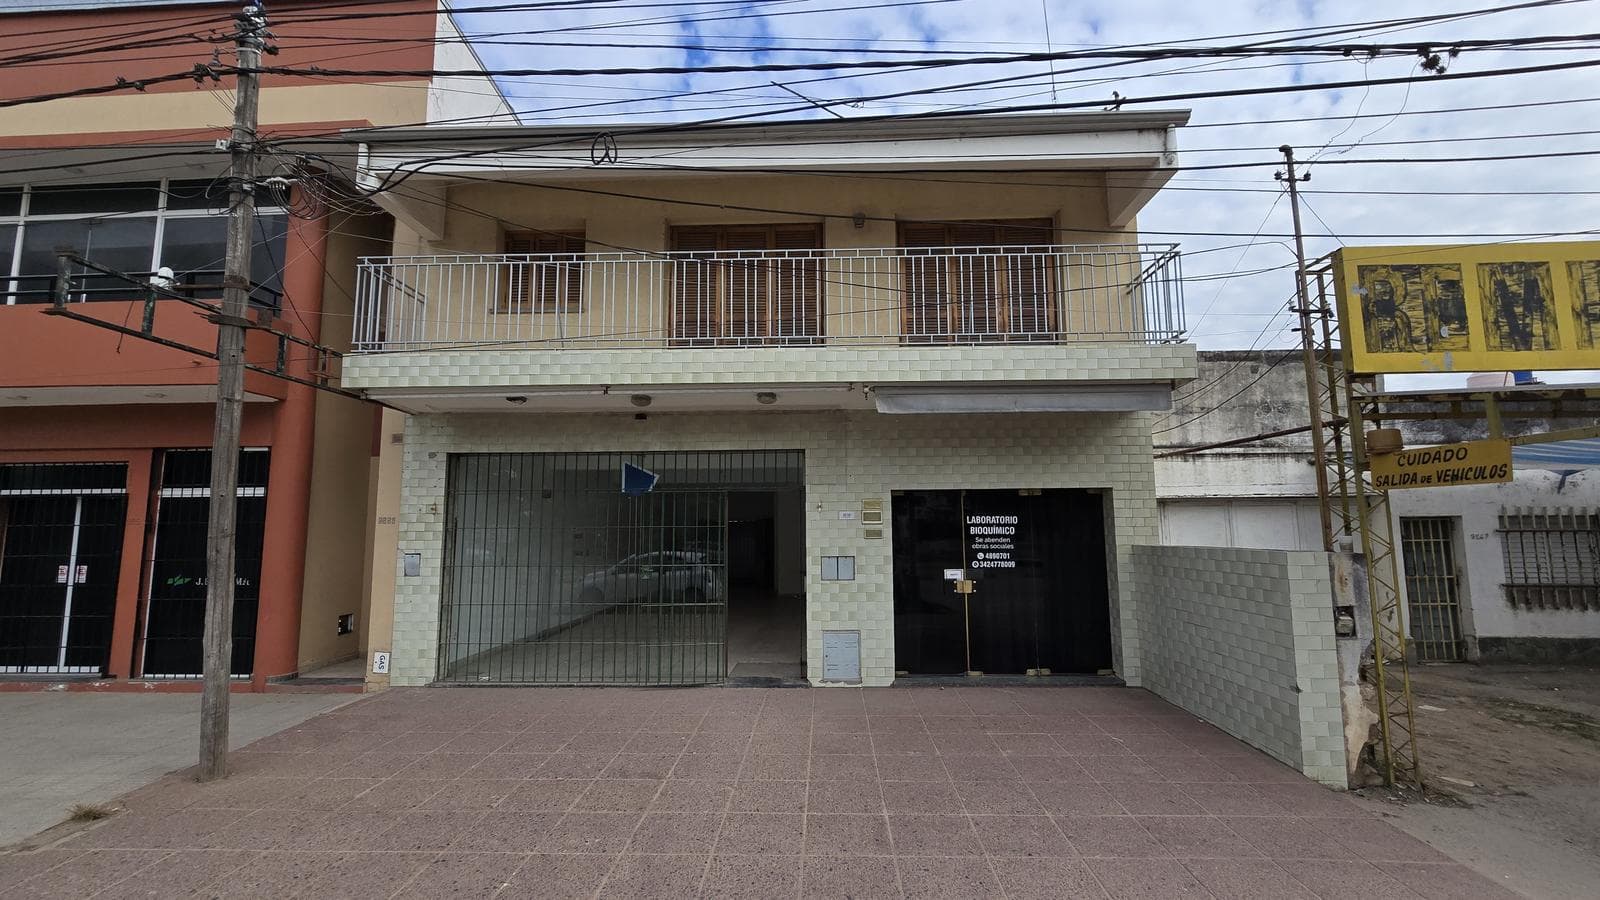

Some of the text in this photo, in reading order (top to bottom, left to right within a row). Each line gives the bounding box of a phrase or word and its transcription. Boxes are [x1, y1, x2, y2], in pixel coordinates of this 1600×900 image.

[1397, 447, 1468, 467] CUIDADO
[1375, 472, 1417, 488] SALIDA
[1435, 463, 1508, 483] VEHICULOS
[966, 515, 1018, 524] LABORATORIO
[970, 525, 1015, 535] BIOQUÍMICO
[975, 536, 983, 544] Se
[378, 655, 386, 670] GAS
